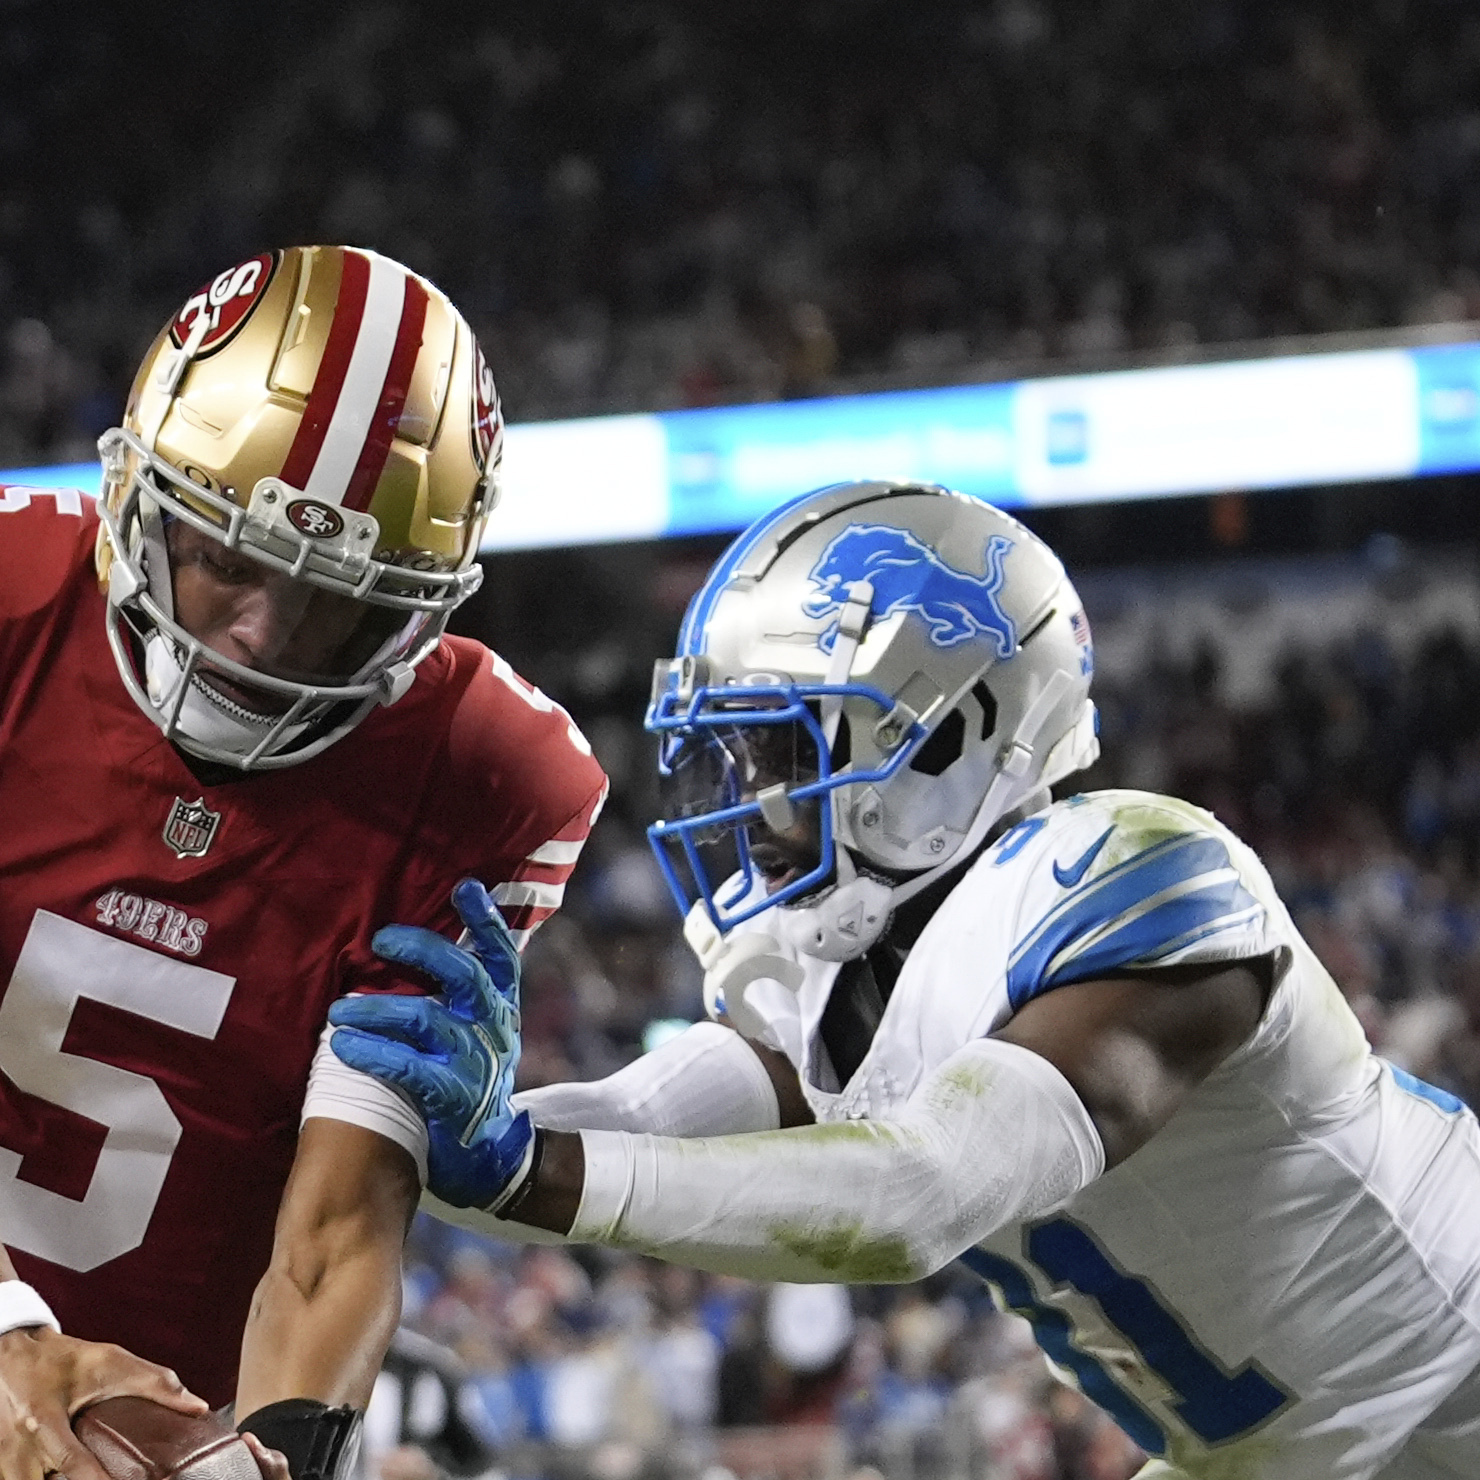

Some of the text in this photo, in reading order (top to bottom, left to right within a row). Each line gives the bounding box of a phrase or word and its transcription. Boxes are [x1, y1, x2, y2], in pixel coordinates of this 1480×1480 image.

[300, 505, 334, 534] SF
[171, 820, 205, 849] NFL
[95, 887, 209, 957] 49ERS
